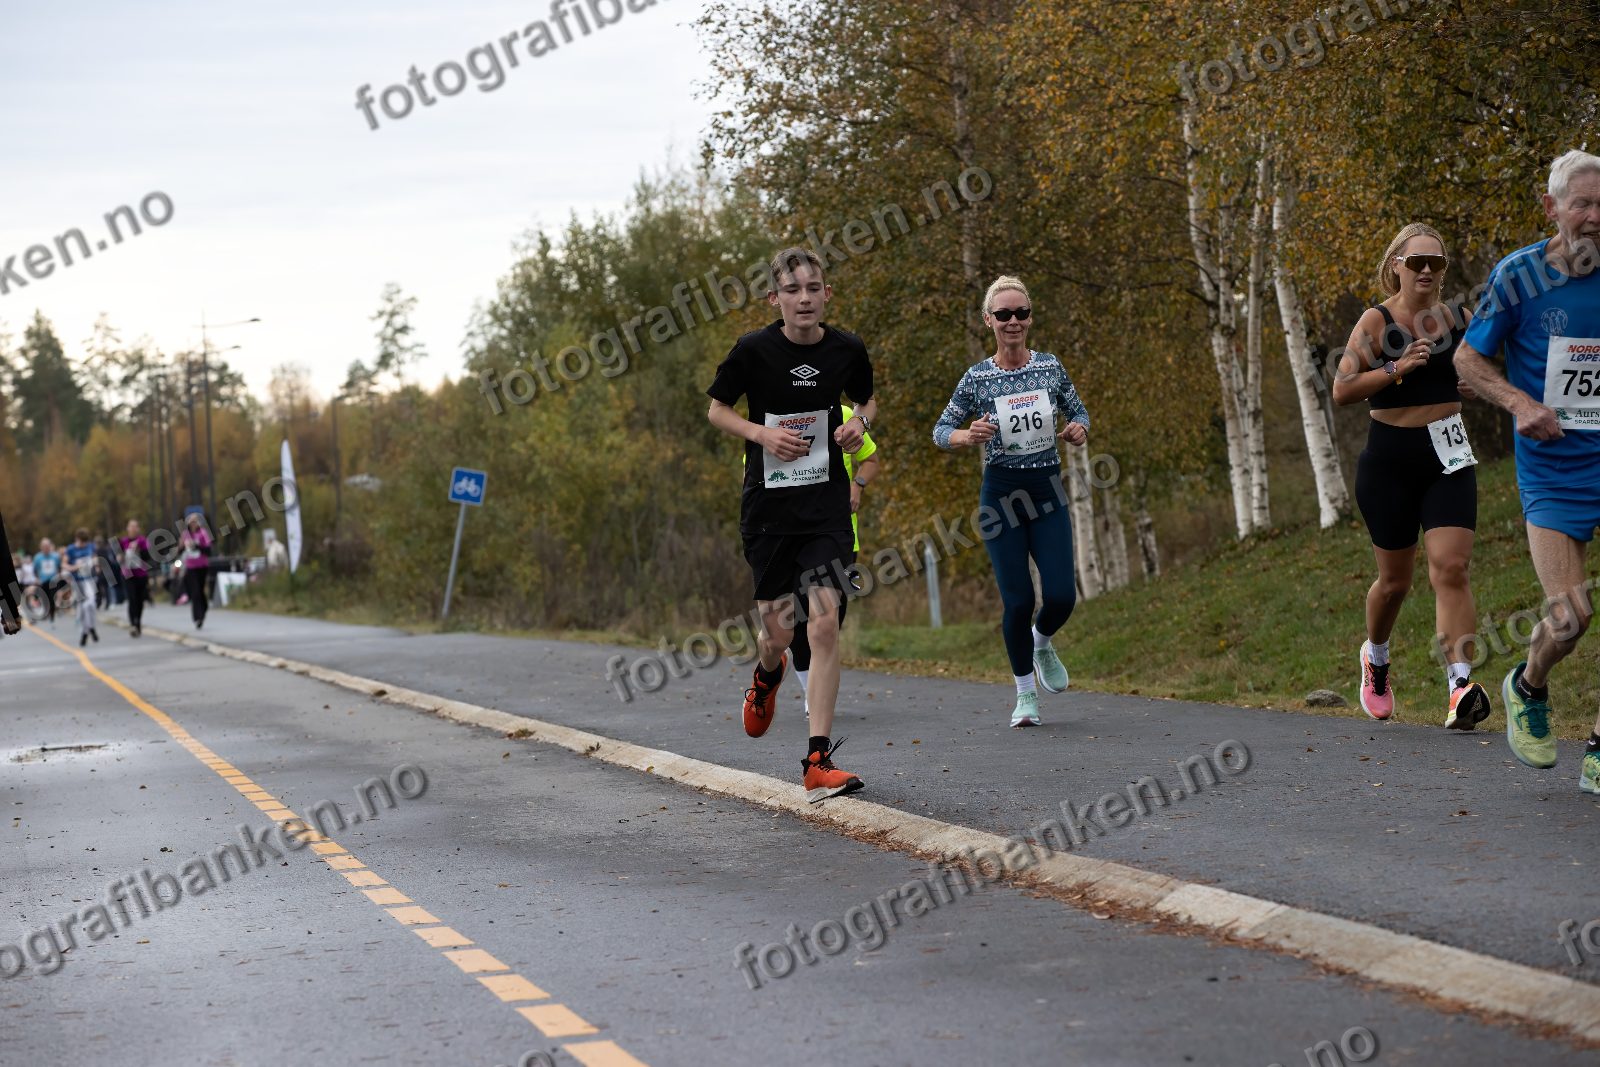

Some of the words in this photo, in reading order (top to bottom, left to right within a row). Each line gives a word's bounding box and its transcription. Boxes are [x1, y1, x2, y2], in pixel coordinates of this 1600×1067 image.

[1567, 344, 1600, 353] NORG
[1570, 354, 1600, 363] LØPE
[792, 379, 817, 387] umbro
[1008, 394, 1039, 406] NORGES
[1011, 401, 1035, 410] LØPET
[778, 416, 817, 426] NORGES
[1009, 411, 1043, 434] 216
[1441, 421, 1468, 448] 13
[799, 435, 816, 456] 7
[791, 466, 827, 477] Aurskog
